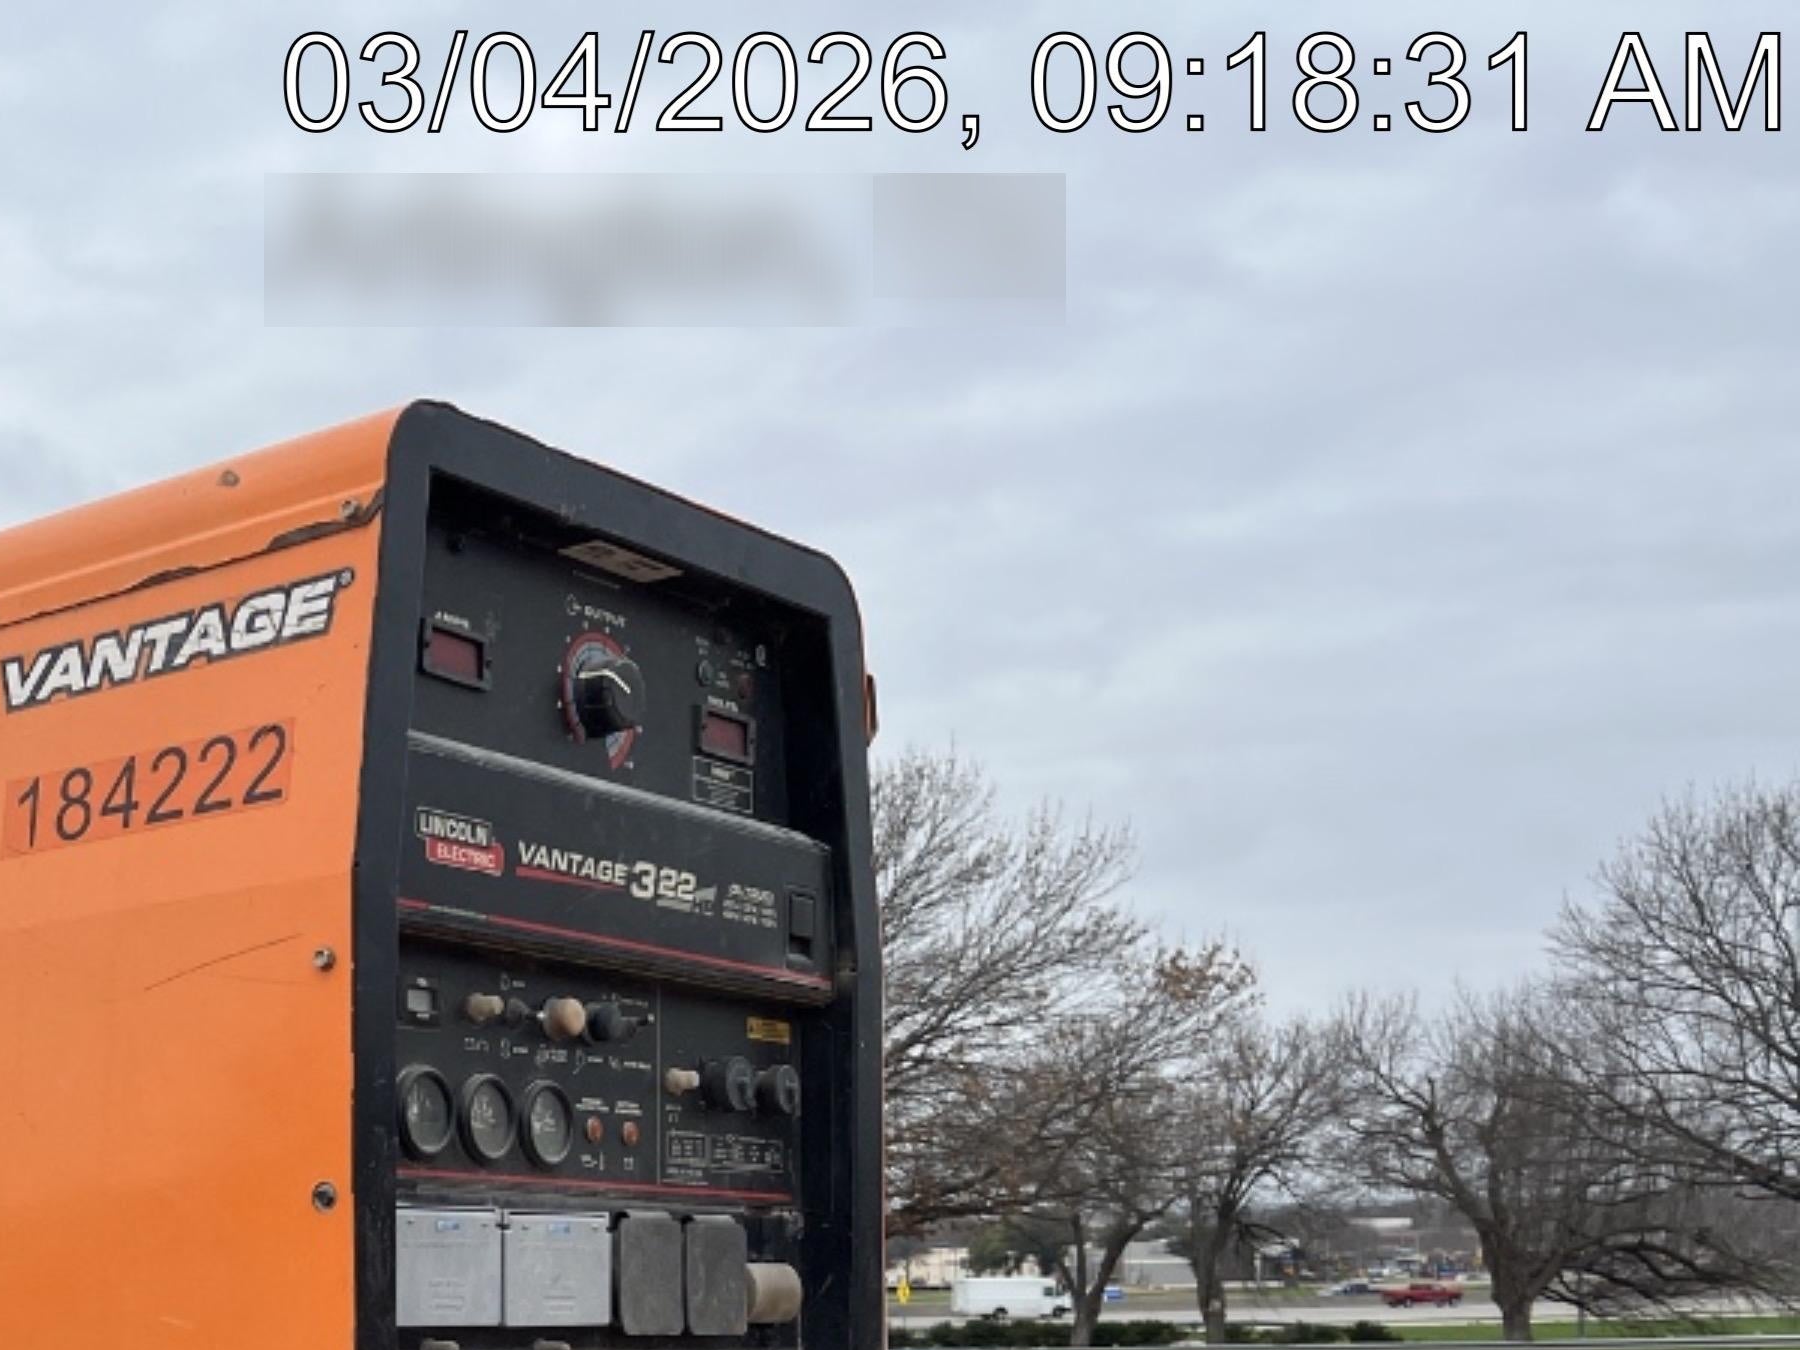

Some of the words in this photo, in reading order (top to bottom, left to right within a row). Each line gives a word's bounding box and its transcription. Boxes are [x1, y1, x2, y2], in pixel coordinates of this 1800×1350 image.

[0, 573, 340, 709] VANTAGE
[17, 722, 288, 849] 184222
[418, 811, 489, 848] LINCOLN
[436, 841, 498, 870] ELECTRIC
[517, 838, 629, 888] VANTAGE
[629, 859, 698, 902] 322
